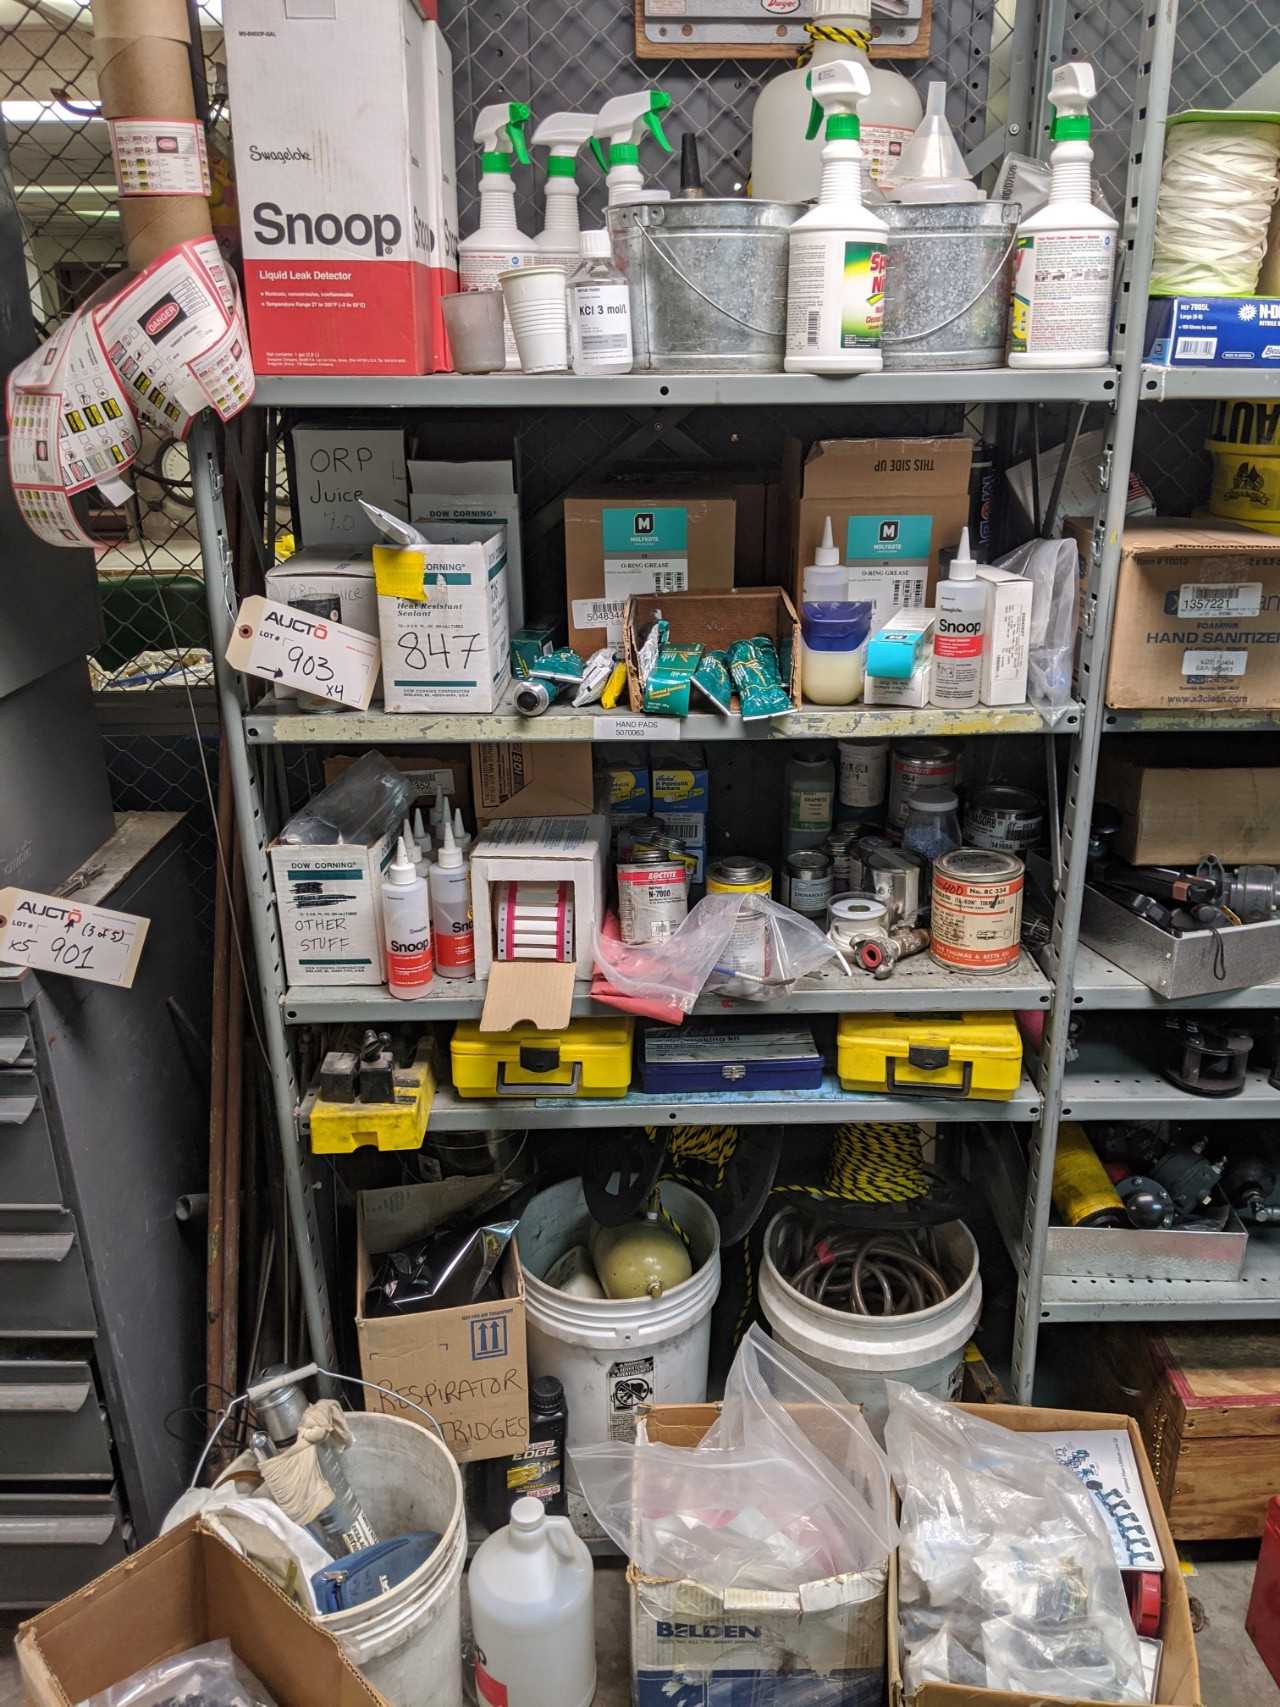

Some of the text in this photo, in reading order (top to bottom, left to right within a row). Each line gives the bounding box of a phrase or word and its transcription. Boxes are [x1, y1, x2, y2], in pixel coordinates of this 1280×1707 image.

[253, 201, 402, 257] Snoop
[259, 270, 353, 281] Liquid Leak Detector
[579, 303, 627, 316] KCl 3 mol/L
[147, 304, 178, 333] DANGER
[310, 447, 374, 474] ORP
[873, 458, 936, 472] THIS SIDE UP
[309, 481, 364, 504] Juice
[429, 510, 450, 518] DOW
[423, 563, 461, 572] ORNING
[1183, 600, 1230, 610] 1357221
[259, 630, 275, 640] LOT
[939, 618, 982, 636] Snoop
[1146, 632, 1199, 644] HAND
[398, 631, 486, 670] 847
[287, 646, 335, 681] 903
[615, 721, 636, 729] HAND
[12, 919, 28, 928] LOT
[294, 917, 347, 931] OTHER
[300, 936, 350, 952] STUFF
[391, 938, 429, 953] Snoop
[51, 937, 94, 969] 901
[376, 1368, 524, 1413] RESPIRATOR
[433, 1416, 528, 1444] TRIDGES
[511, 1446, 558, 1462] EDGE
[656, 1620, 762, 1638] BELDEN
